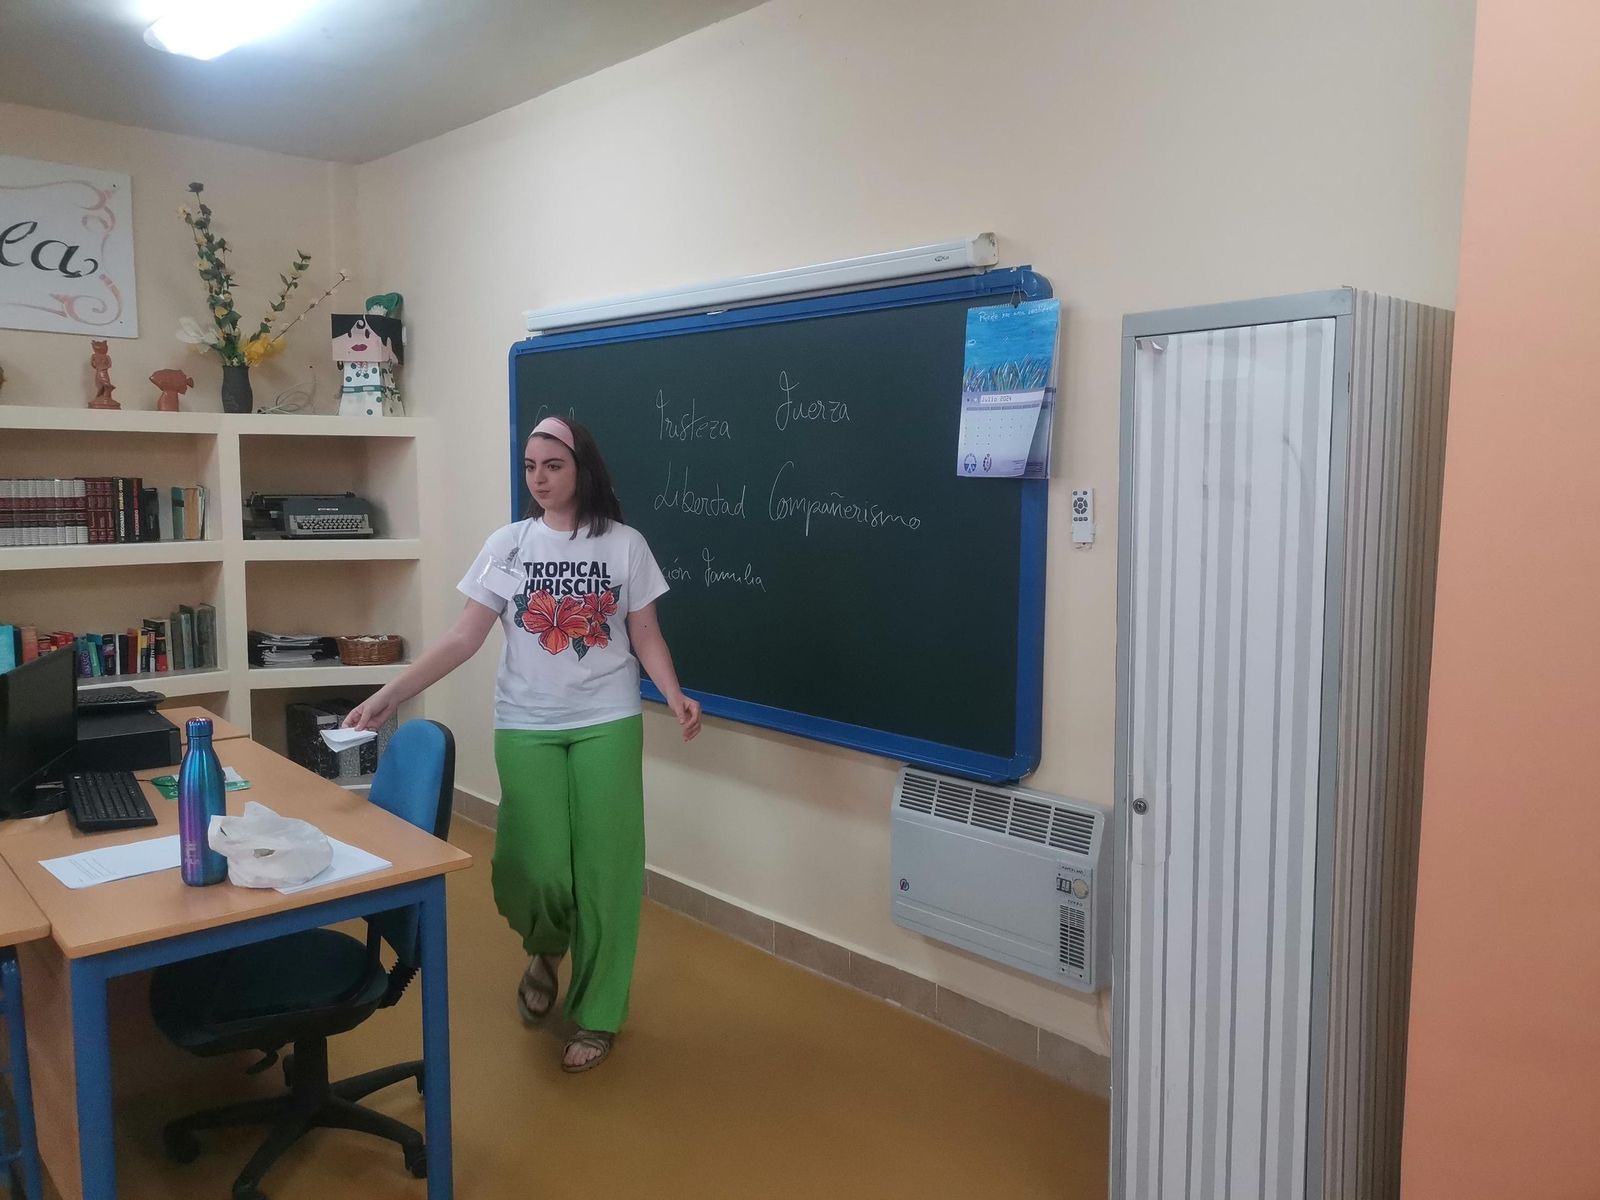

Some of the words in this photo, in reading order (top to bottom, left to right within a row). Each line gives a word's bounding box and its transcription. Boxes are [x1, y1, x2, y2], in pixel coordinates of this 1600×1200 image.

[655, 389, 731, 441] Tristeza
[776, 370, 850, 431] Fuerza
[654, 461, 746, 519] Libertad
[768, 460, 921, 537] Compañerismo
[523, 561, 611, 579] TROPICAL
[523, 578, 611, 597] HIBISCUS
[702, 547, 767, 593] Familia
